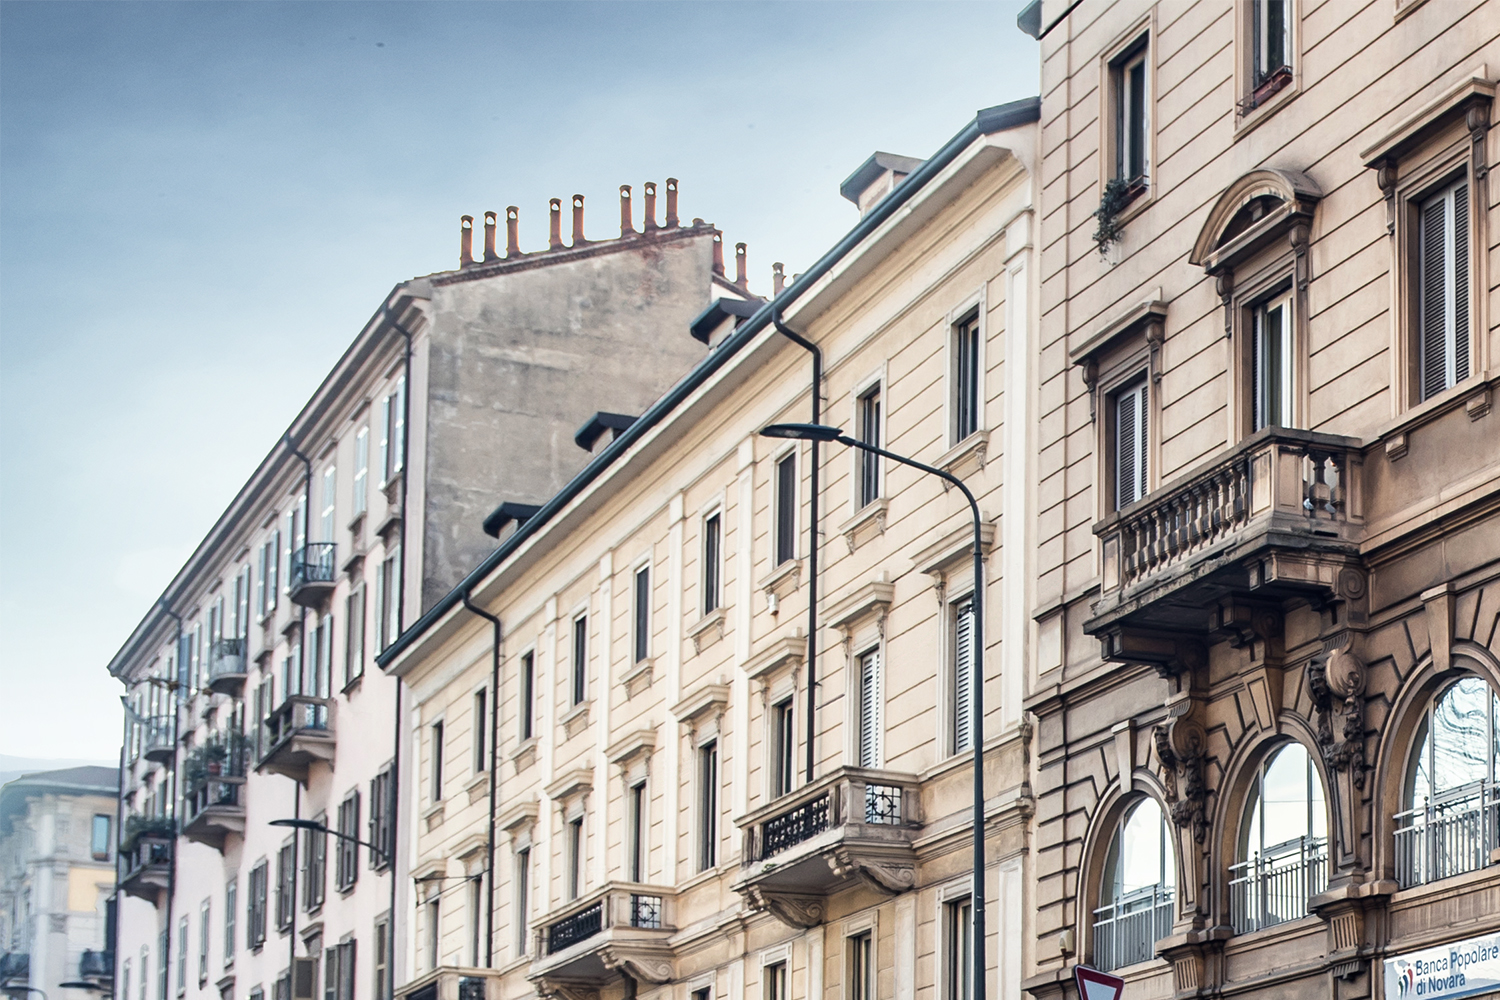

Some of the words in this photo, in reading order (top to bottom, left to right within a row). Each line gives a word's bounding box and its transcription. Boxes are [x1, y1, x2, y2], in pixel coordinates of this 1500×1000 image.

[1415, 958, 1448, 977] Banca
[1450, 945, 1499, 970] Popolare
[1416, 976, 1426, 996] di
[1428, 972, 1466, 993] Novara
